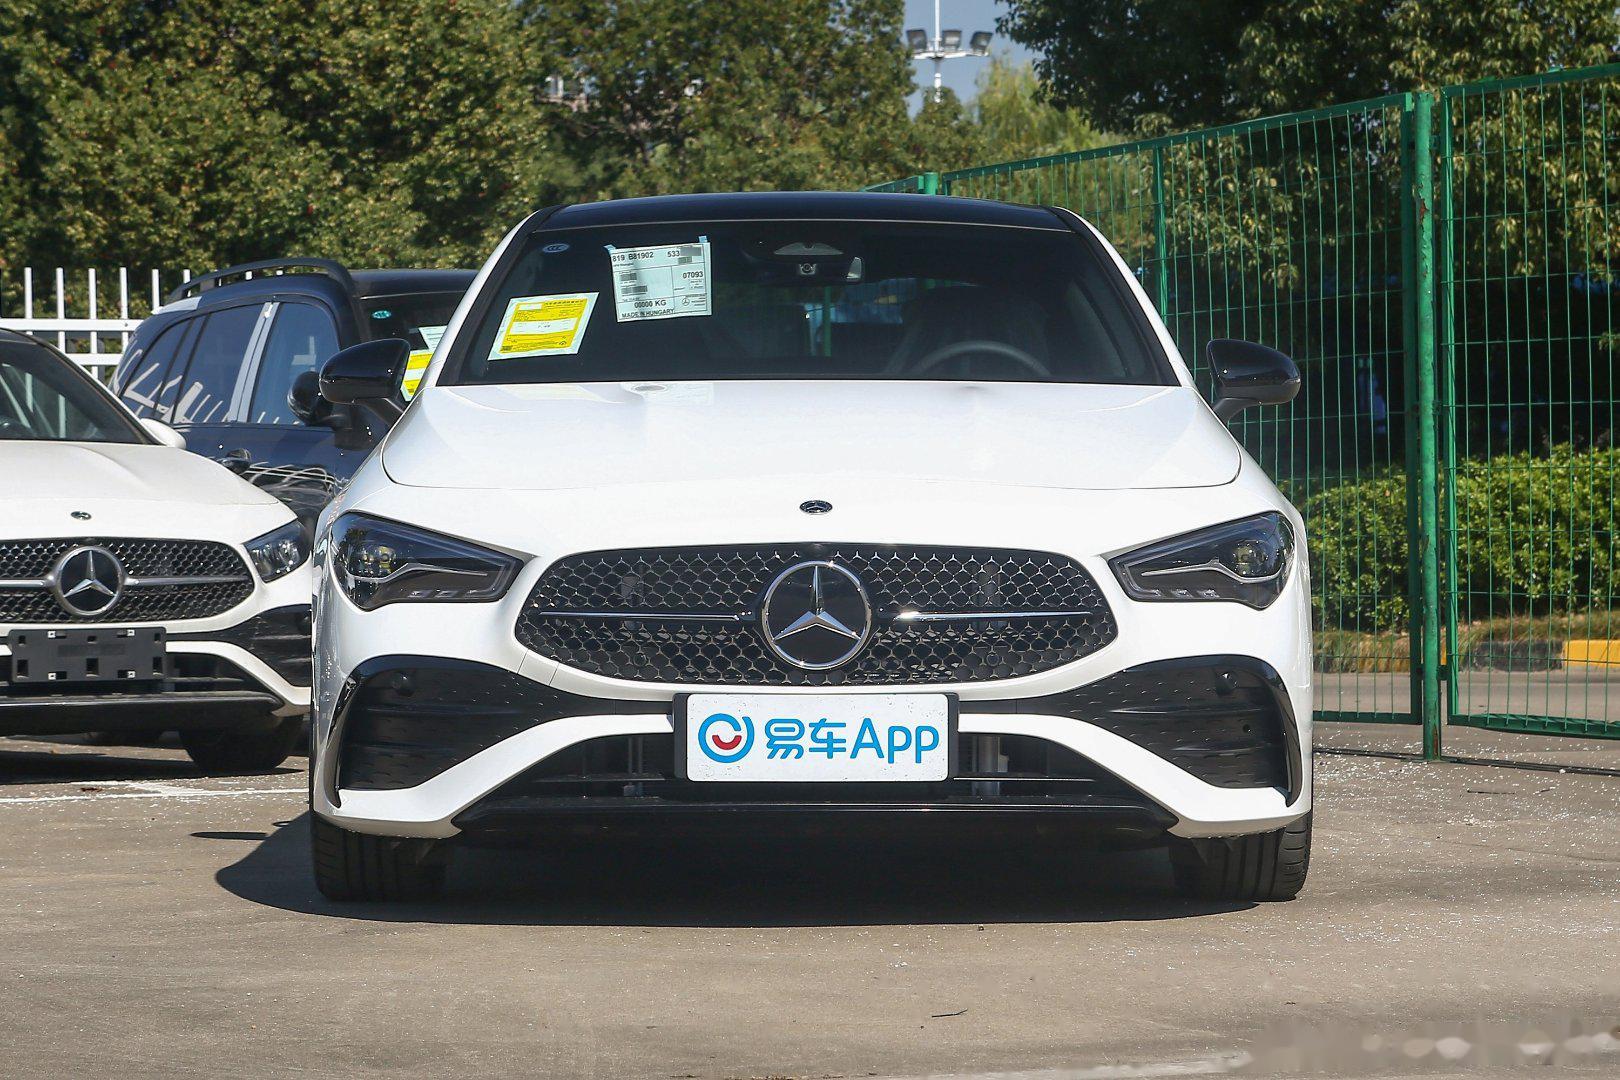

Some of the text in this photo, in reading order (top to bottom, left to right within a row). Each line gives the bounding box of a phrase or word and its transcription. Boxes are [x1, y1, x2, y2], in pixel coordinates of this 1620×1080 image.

[612, 254, 625, 262] 819
[628, 251, 654, 260] B81902
[682, 271, 704, 279] 07093
[646, 308, 674, 316] HUNGARY
